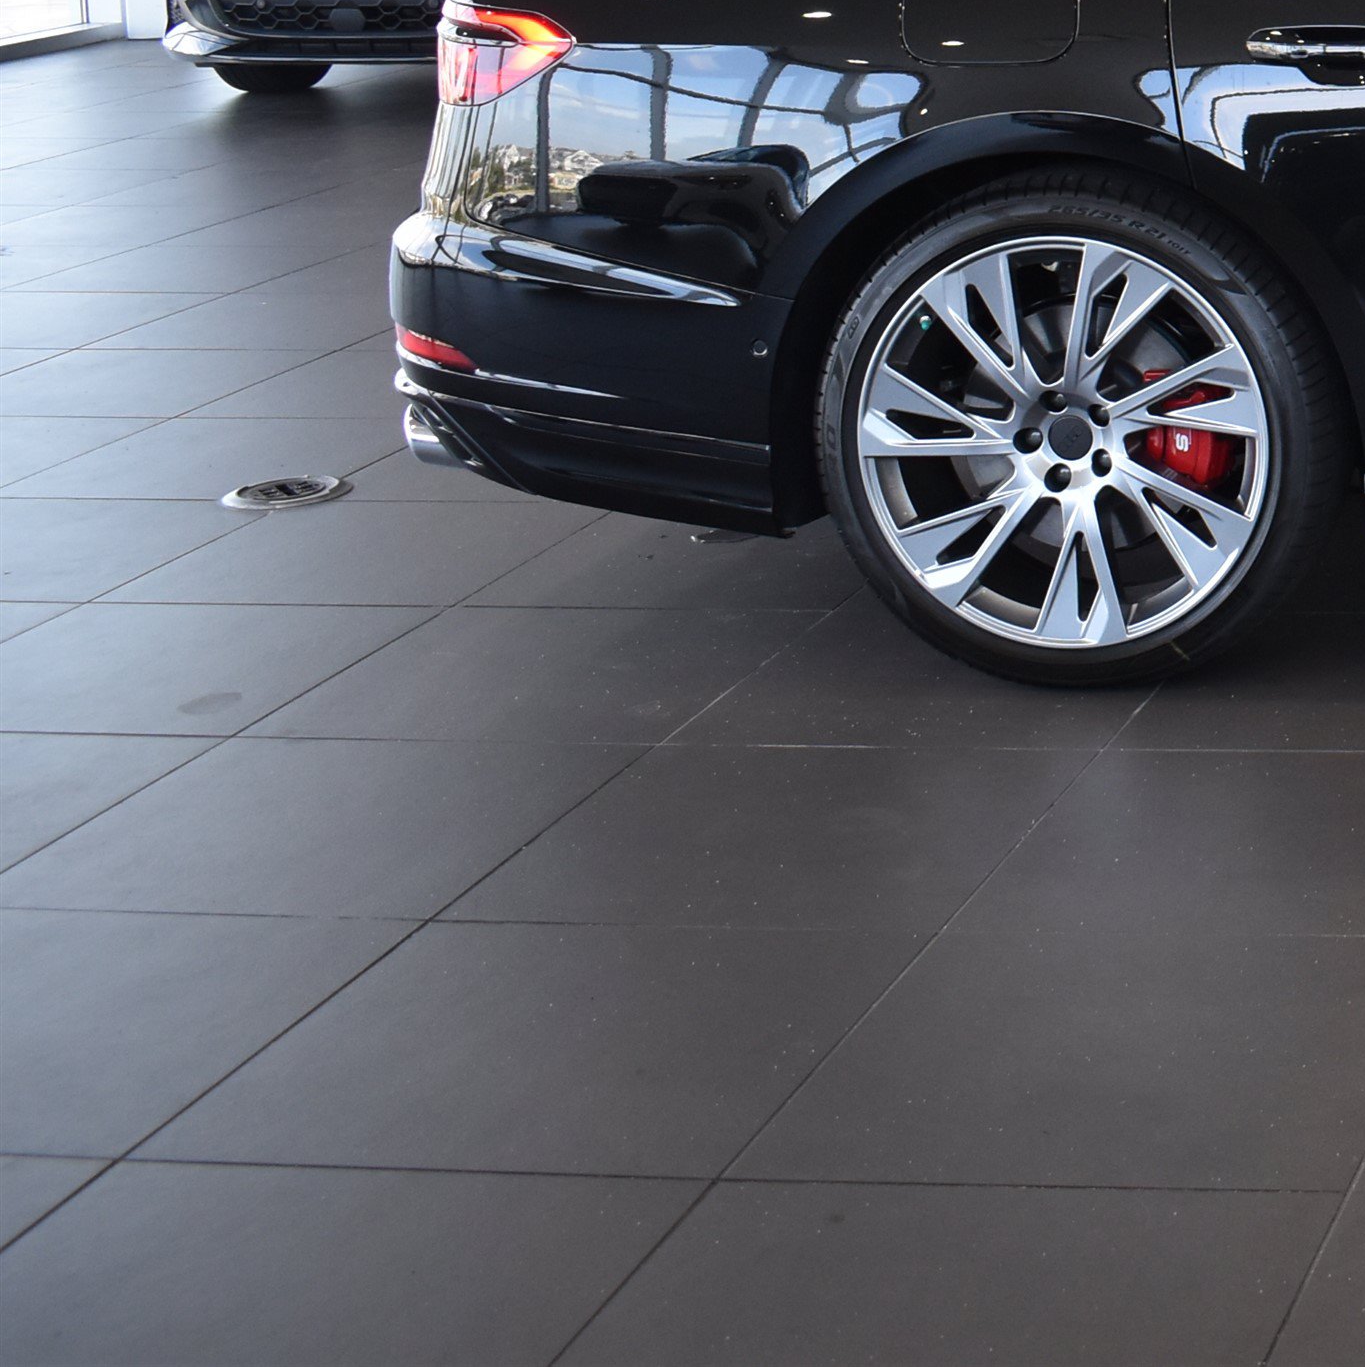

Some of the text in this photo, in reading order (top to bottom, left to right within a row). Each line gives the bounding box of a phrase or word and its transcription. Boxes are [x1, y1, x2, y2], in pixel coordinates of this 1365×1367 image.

[1049, 205, 1127, 224] 265/35
[1129, 220, 1146, 233] R
[1175, 433, 1189, 452] S
